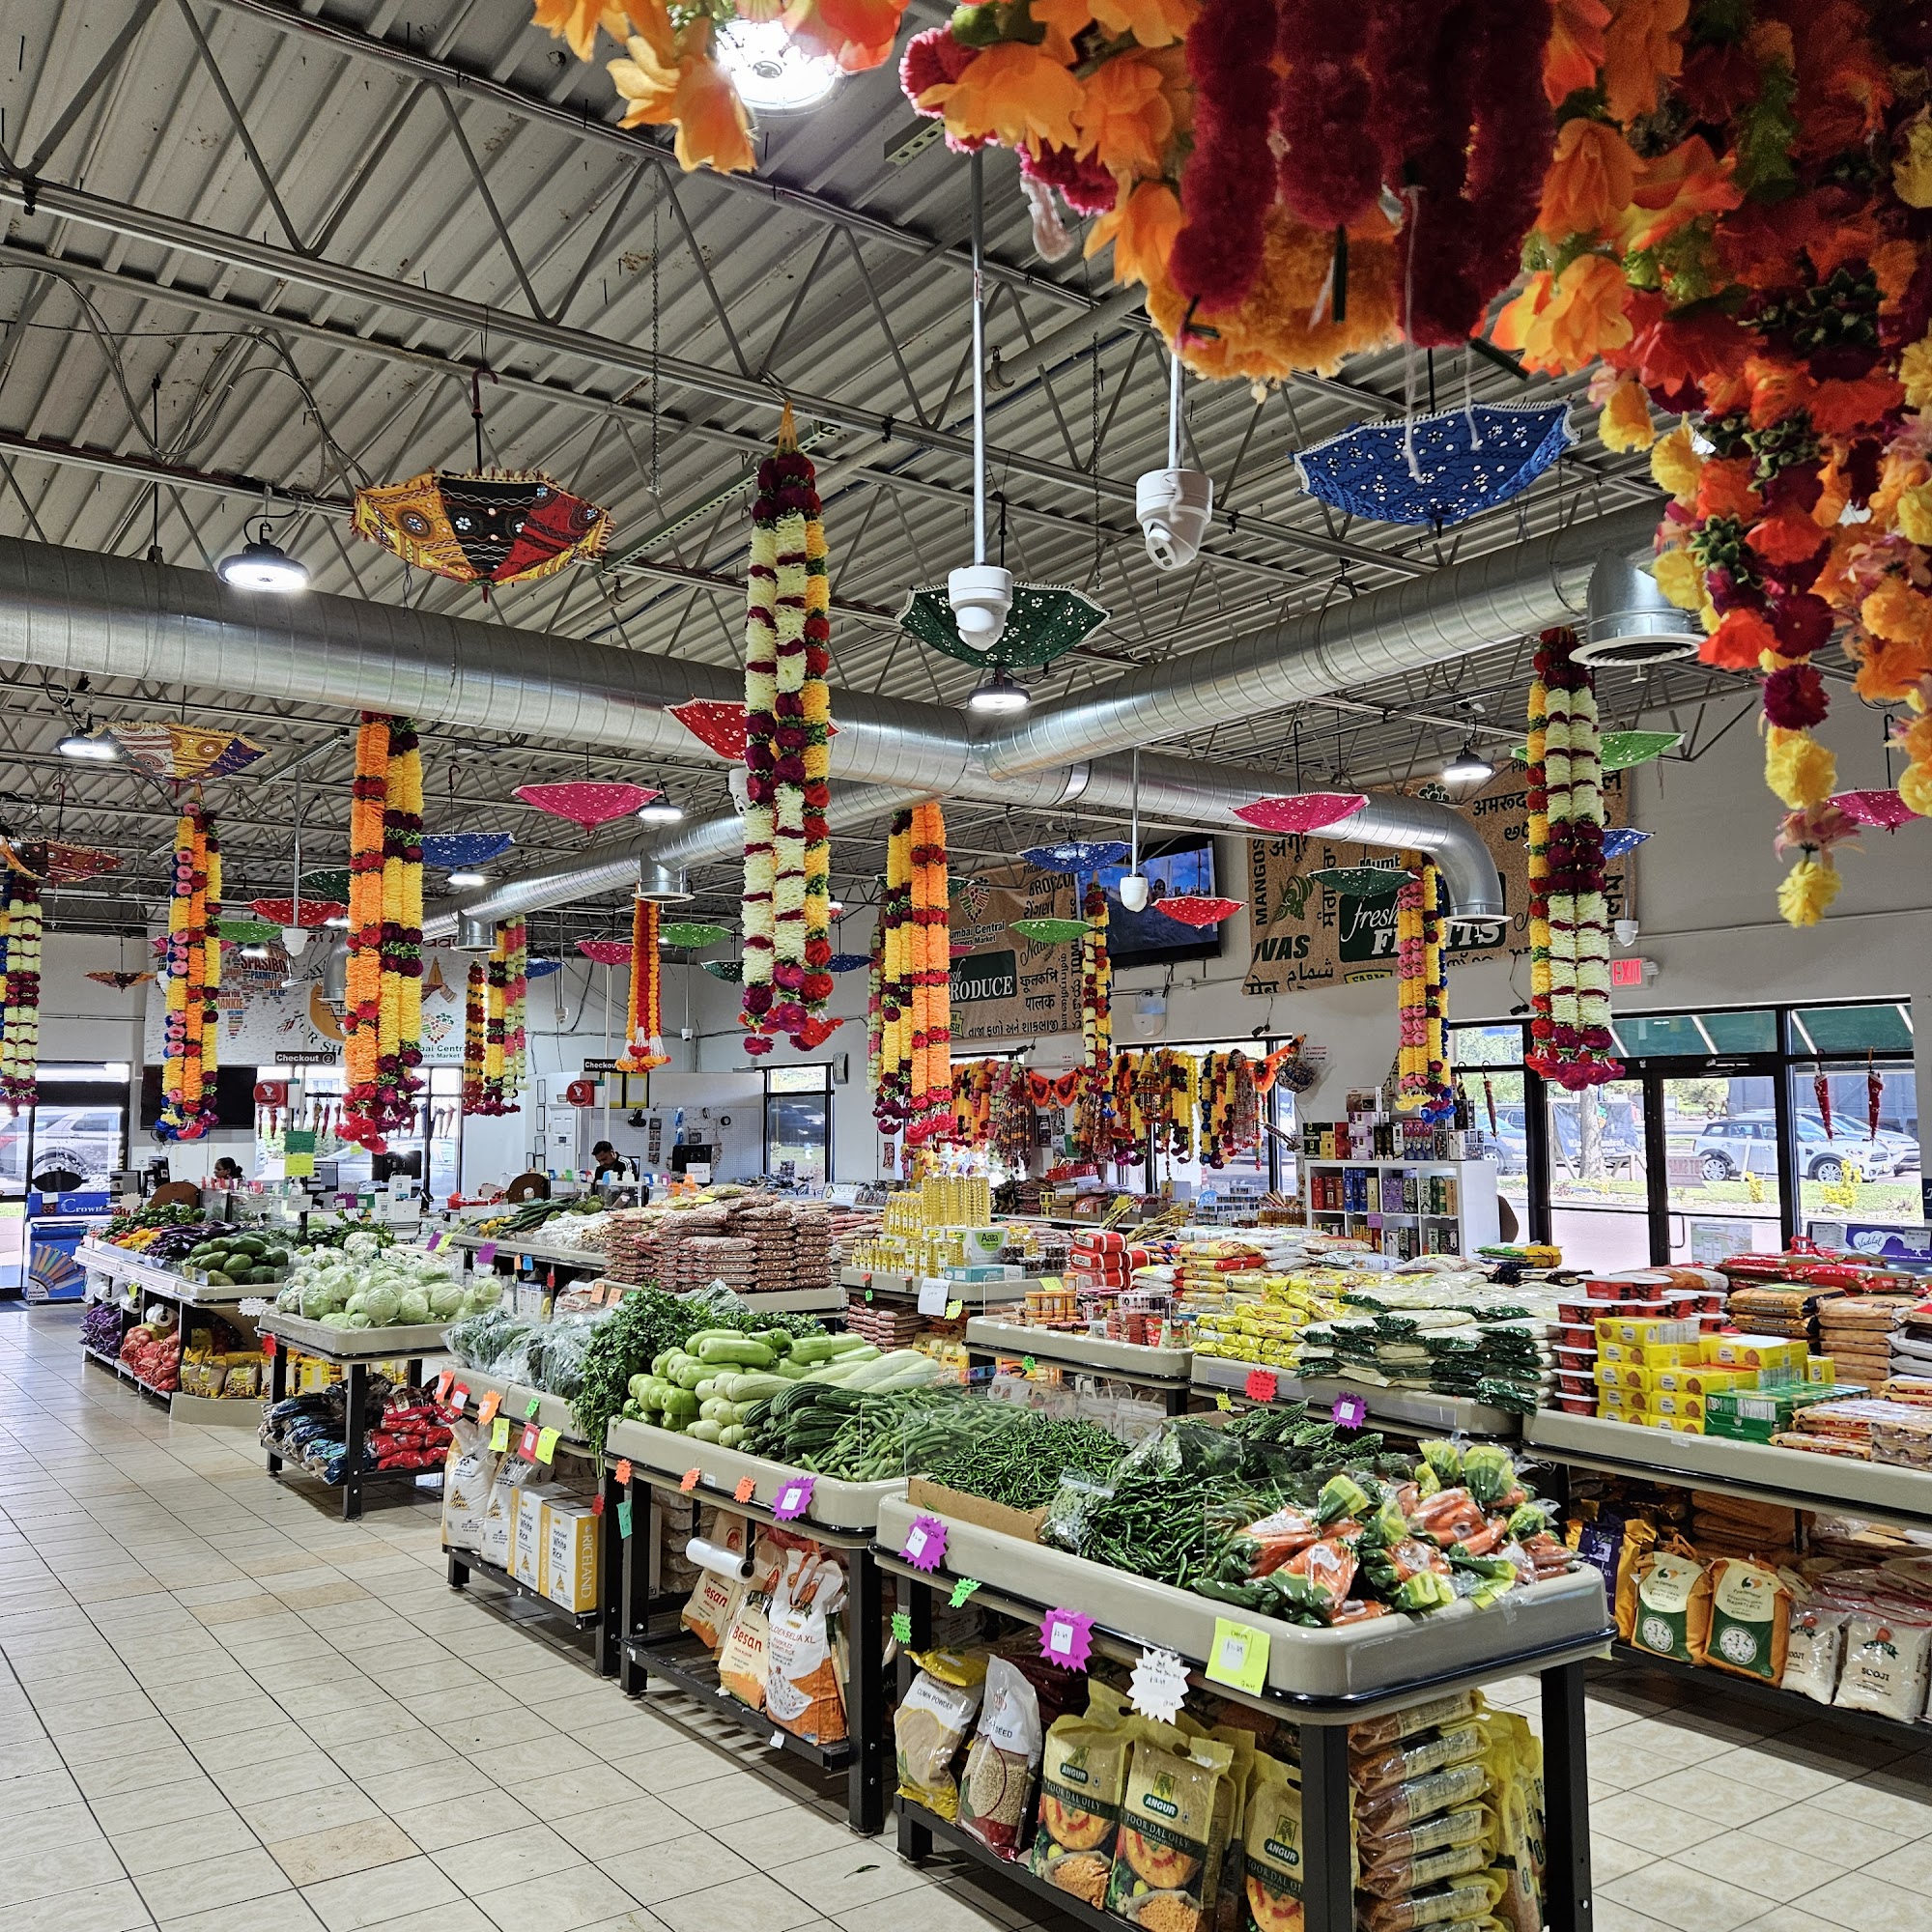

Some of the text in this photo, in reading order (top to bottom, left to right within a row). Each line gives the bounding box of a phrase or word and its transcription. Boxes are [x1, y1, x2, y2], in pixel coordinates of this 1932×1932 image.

[1268, 833, 1307, 864] अगूर
[1359, 854, 1401, 868] Mumb
[1029, 873, 1075, 896] BROCCOL
[1253, 838, 1267, 925] MANGOS
[951, 921, 1005, 939] umbai Central
[975, 935, 996, 945] Market
[242, 955, 287, 973] SPASIBO
[1613, 959, 1641, 985] EXIT
[951, 976, 1013, 1001] RODUCE
[1025, 995, 1056, 1010] पालक
[581, 1535, 593, 1599] RICELAND
[732, 1626, 762, 1653] Besan
[805, 1634, 816, 1643] XL
[1787, 1651, 1804, 1660] OOJI
[1861, 1667, 1889, 1681] SOOJI
[917, 1688, 953, 1710] CUMIN POWDER
[995, 1725, 1013, 1738] SEED
[1061, 1764, 1087, 1781] ANGUR
[1047, 1783, 1101, 1811] TOOR DAL OILY
[1145, 1796, 1177, 1816] ANGUR
[1126, 1812, 1148, 1830] TOOR
[1150, 1822, 1166, 1838] DAL
[1168, 1833, 1190, 1849] OILY
[1266, 1842, 1296, 1862] ANGUR
[1247, 1859, 1301, 1892] TOOR DAL OI
